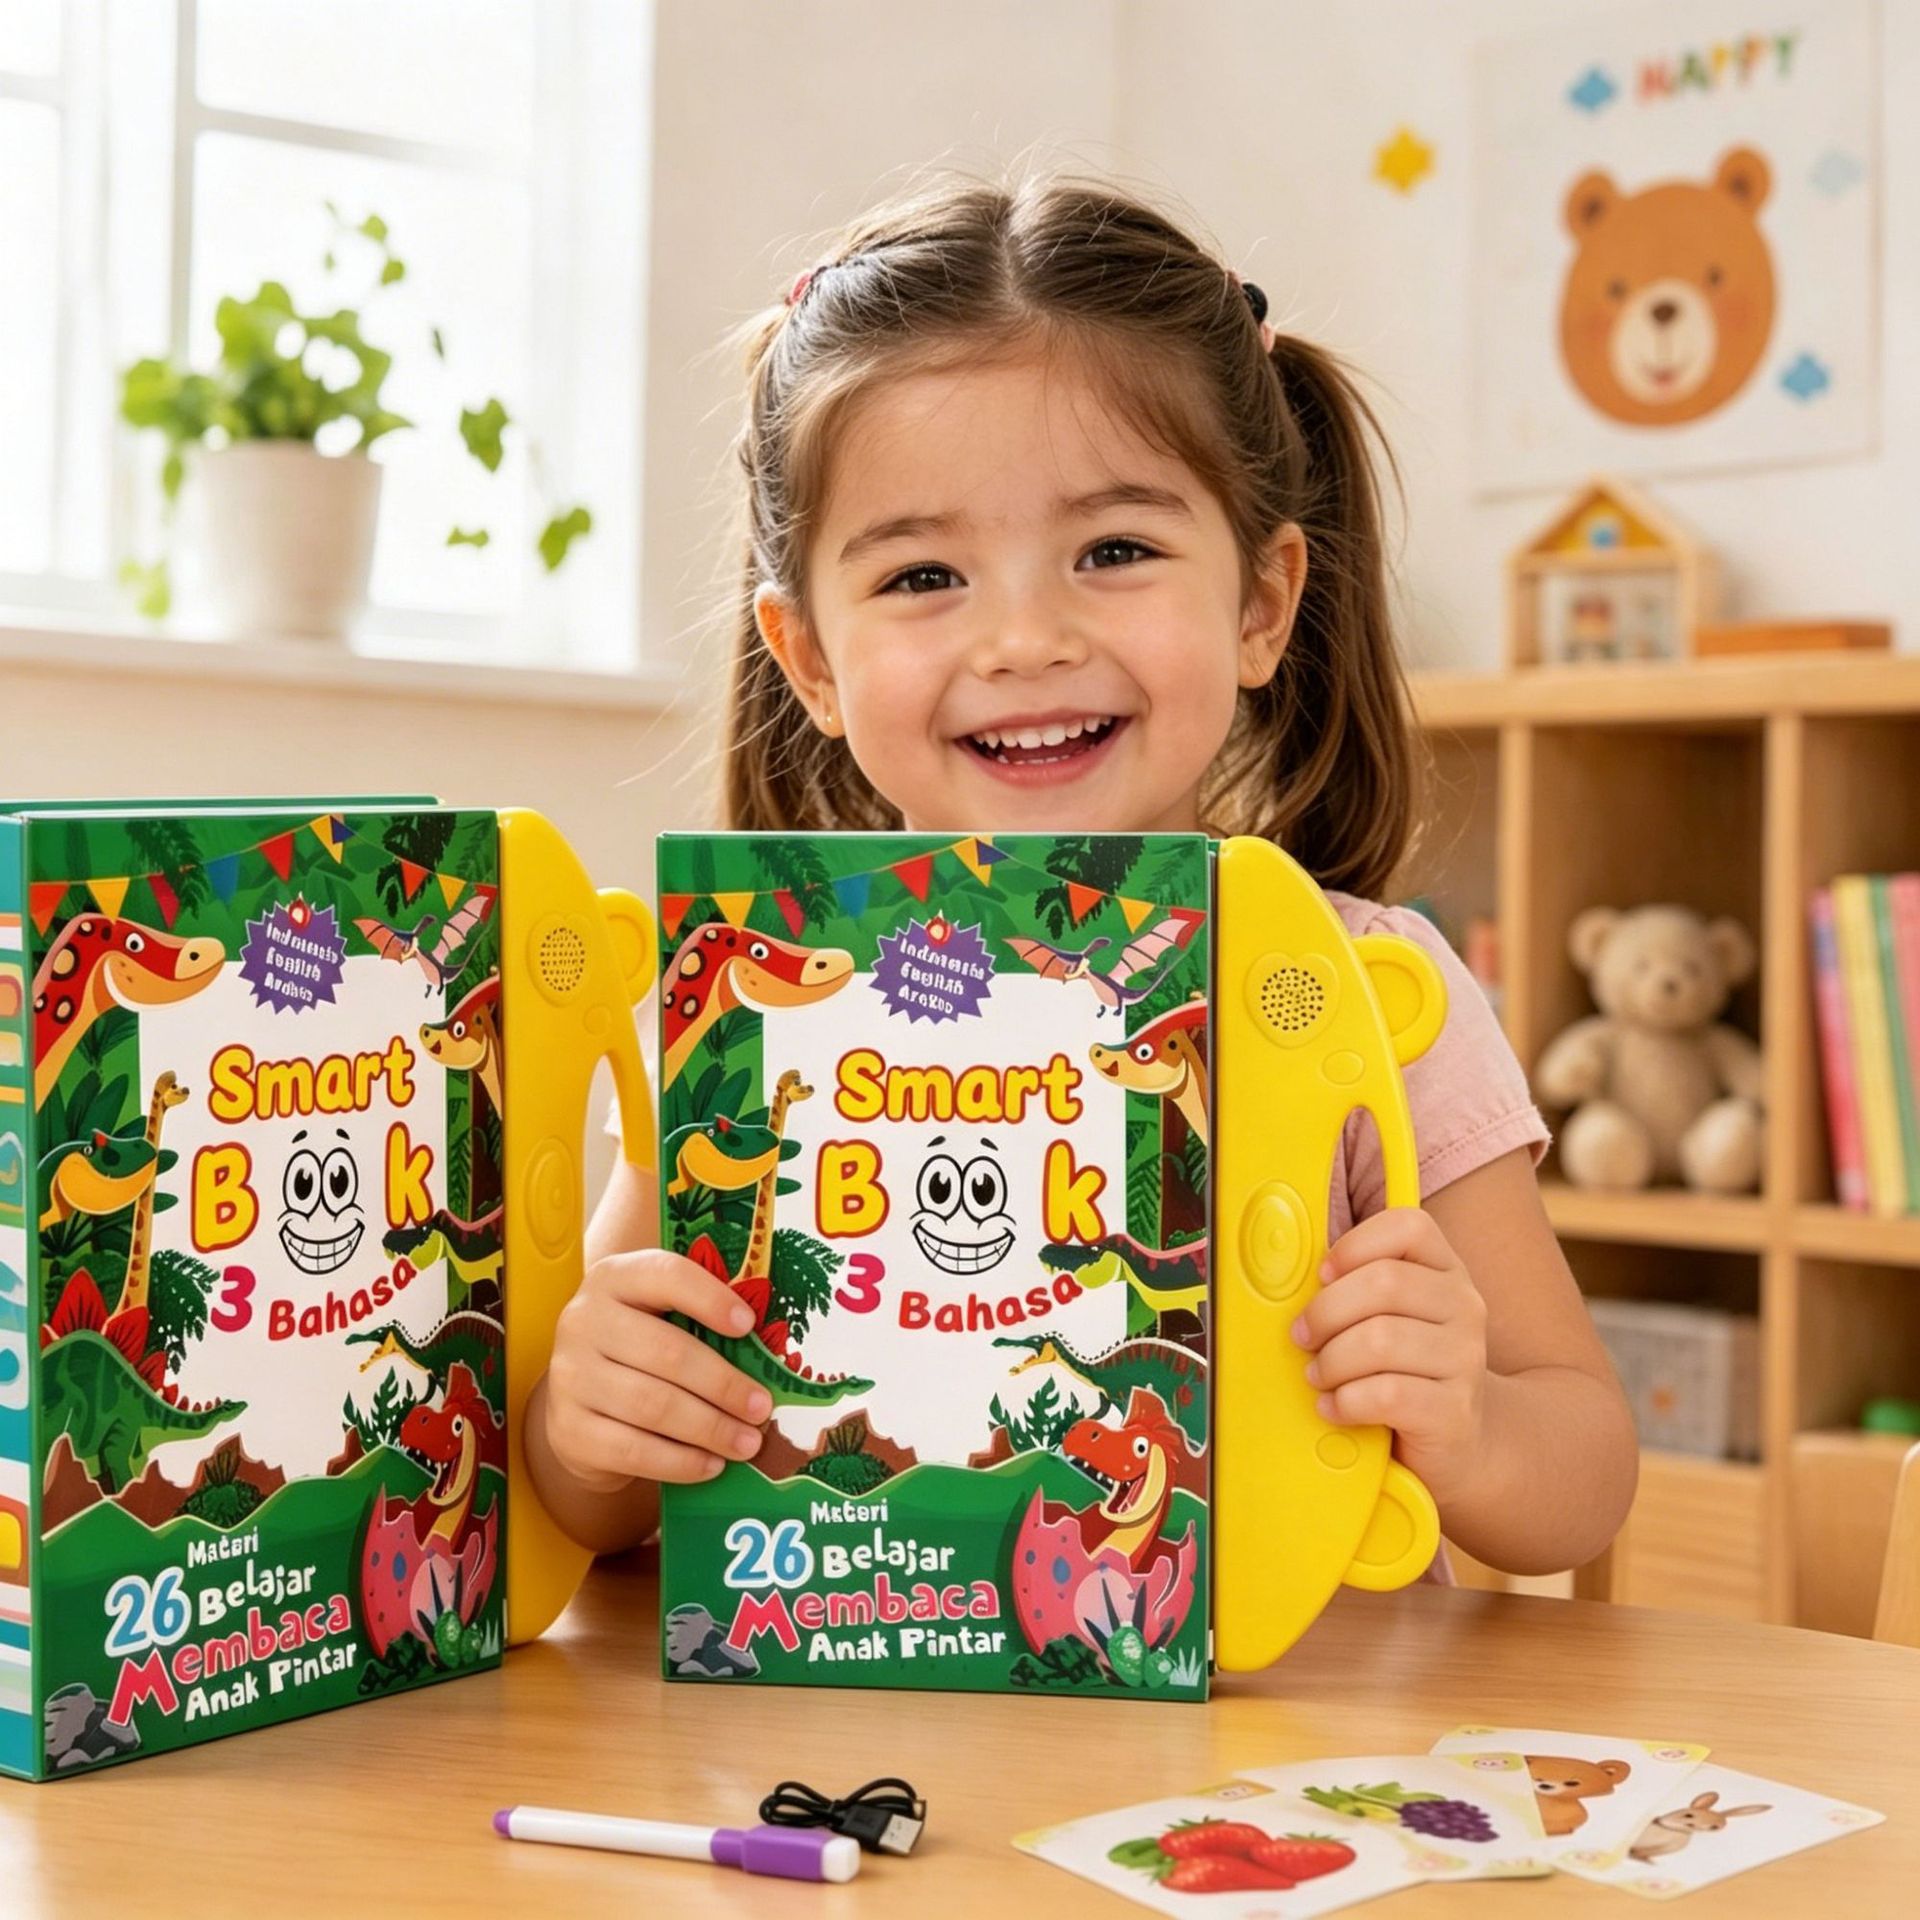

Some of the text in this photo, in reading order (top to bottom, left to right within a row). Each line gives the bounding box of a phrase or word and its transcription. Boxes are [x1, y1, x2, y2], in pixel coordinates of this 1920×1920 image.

[208, 1035, 415, 1125] Smart
[834, 1047, 1084, 1124] Smart
[210, 1256, 418, 1341] 3 Bahasa
[835, 1253, 1084, 1334] 3 Bahasa
[723, 1518, 956, 1589] 26 Belajar
[104, 1559, 317, 1658] 26 Belajar
[725, 1573, 1001, 1653] Membaca
[808, 1628, 1007, 1663] Anak Pintar
[107, 1594, 352, 1727] Membaca
[184, 1642, 358, 1722] Anak Pintar
